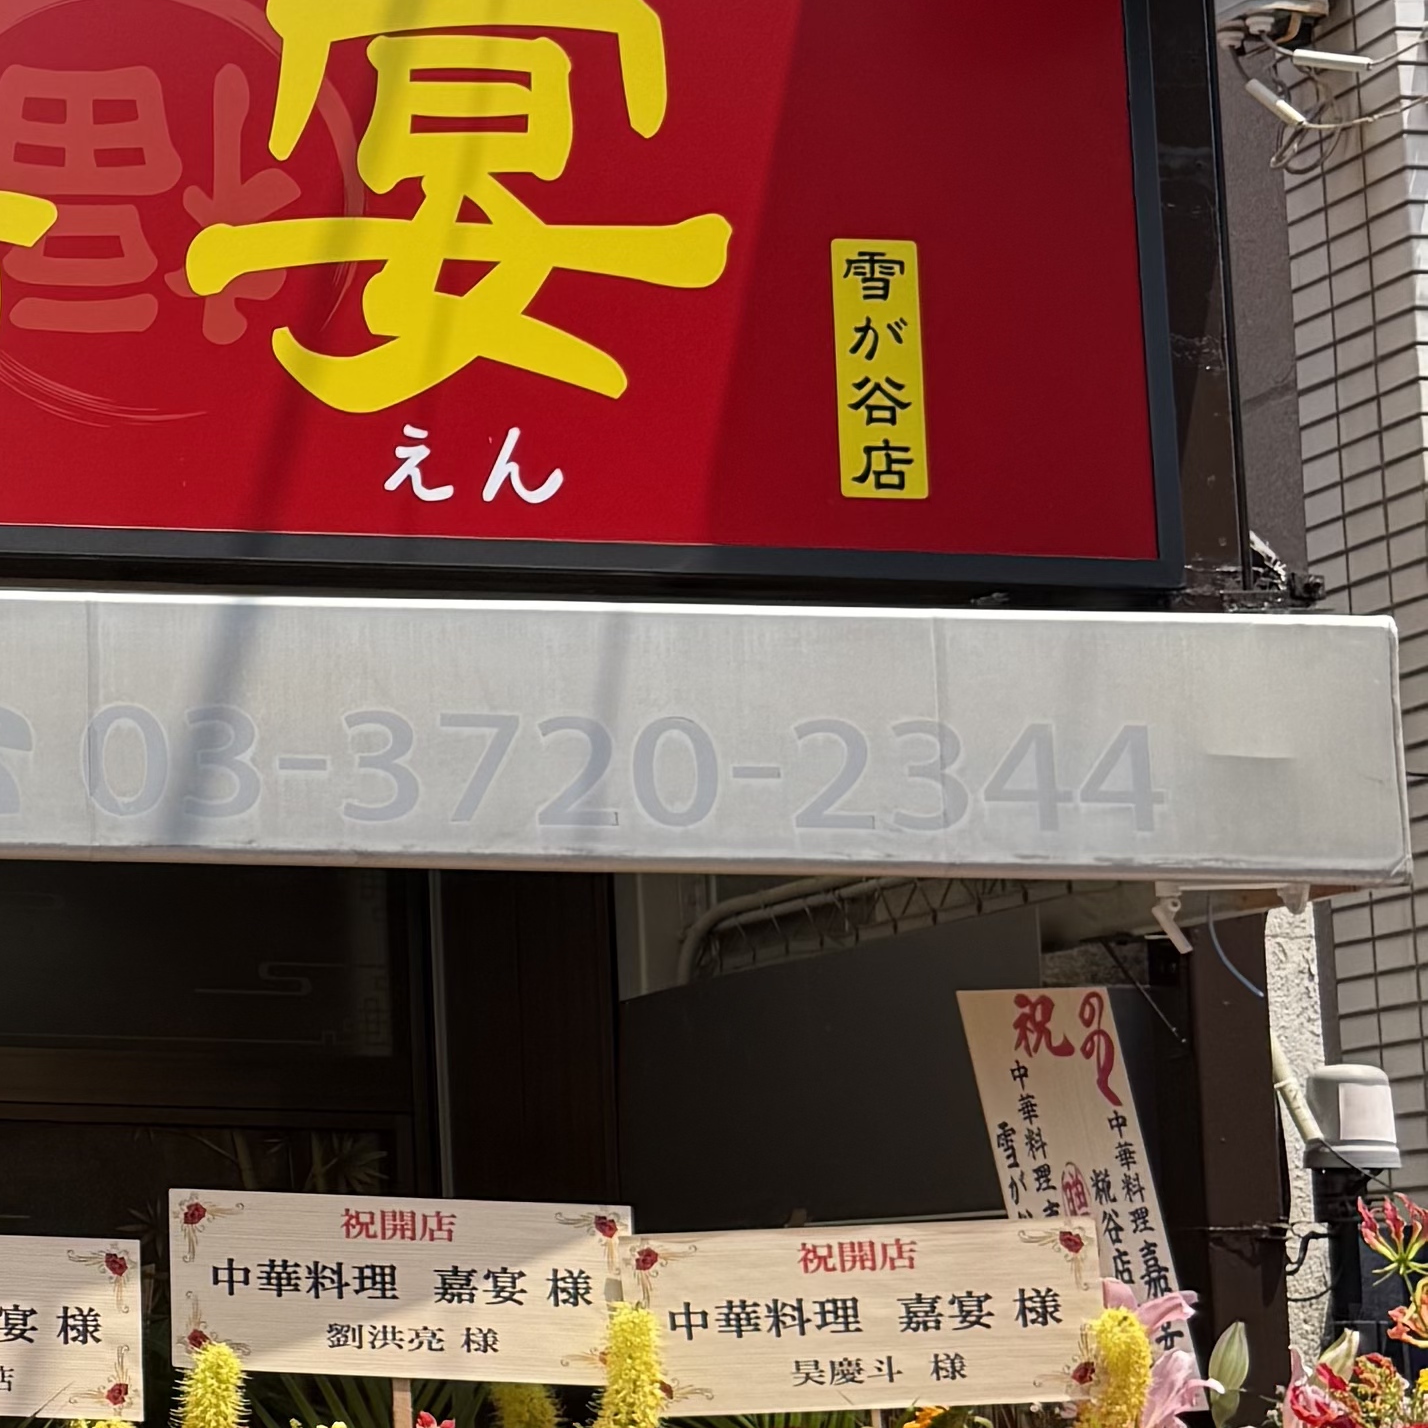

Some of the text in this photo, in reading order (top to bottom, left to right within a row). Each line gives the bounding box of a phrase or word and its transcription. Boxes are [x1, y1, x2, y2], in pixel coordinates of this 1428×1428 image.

[843, 250, 919, 494] 雪が谷店
[385, 423, 564, 504] えん
[85, 701, 1164, 834] 03-3720-2344
[1013, 993, 1075, 1057] 祝
[996, 1122, 1033, 1219] 雪が
[340, 1207, 457, 1244] 祝開店
[211, 1256, 594, 1309] 中華料理 嘉宴 様
[799, 1238, 918, 1274] 祝開店
[56, 1304, 104, 1347] 様
[326, 1322, 500, 1354] 劉洪亮 様
[668, 1287, 1063, 1341] 中華料理 嘉宴 様
[930, 1352, 967, 1382] 様
